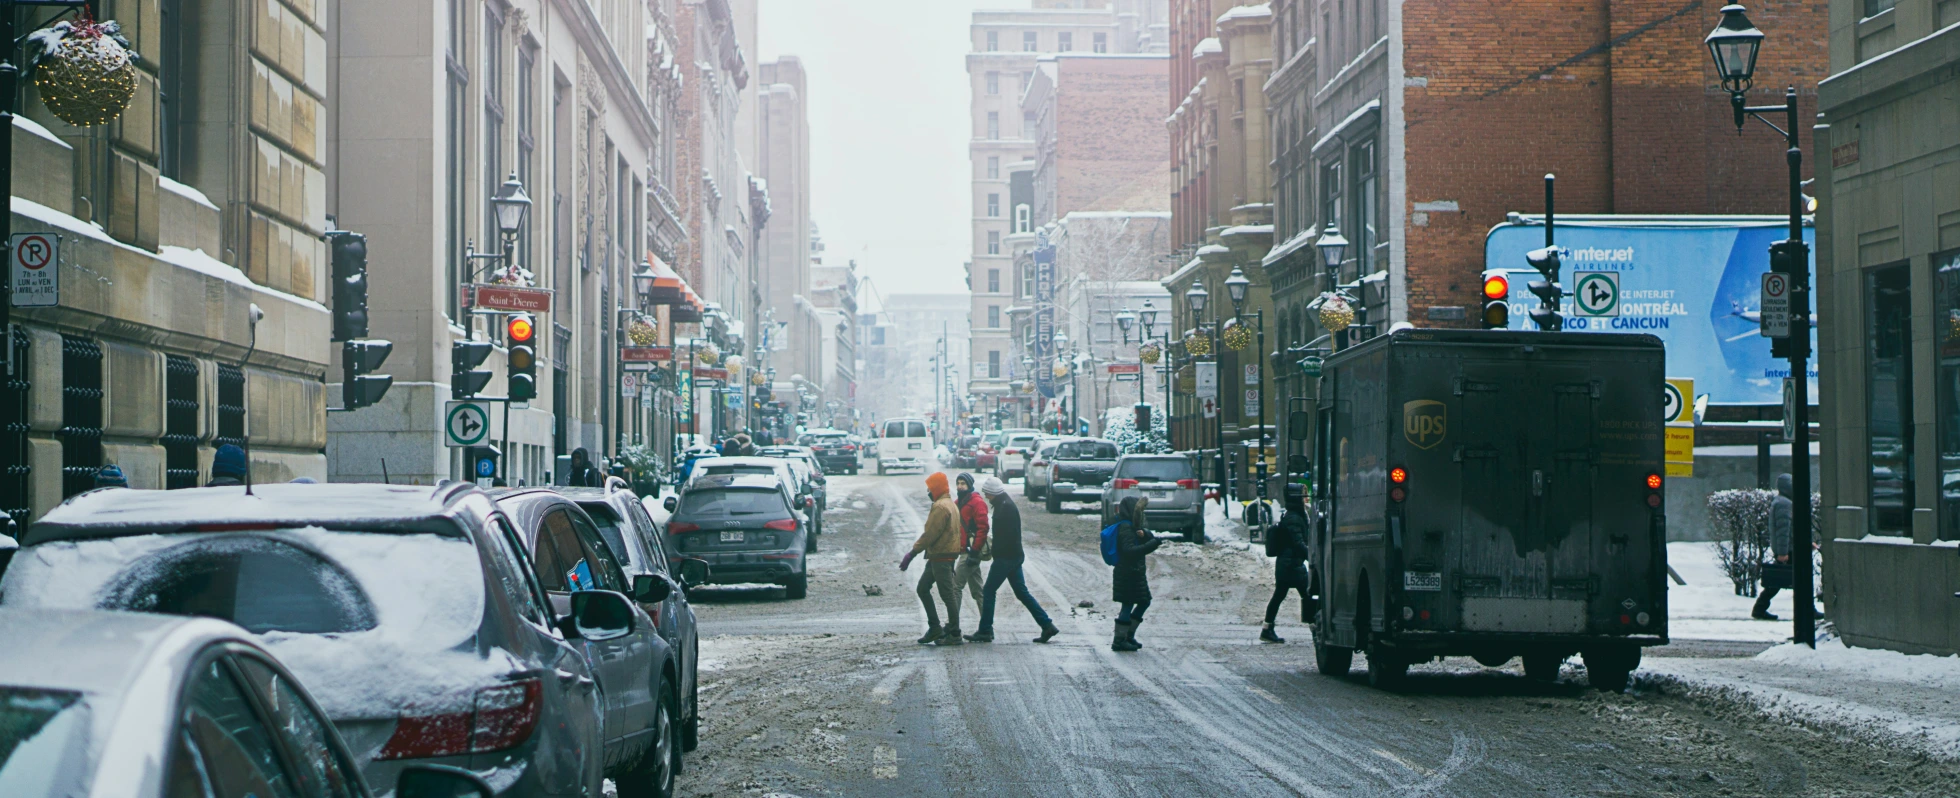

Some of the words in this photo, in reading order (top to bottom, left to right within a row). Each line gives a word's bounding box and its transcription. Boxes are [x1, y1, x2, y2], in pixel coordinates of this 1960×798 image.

[1573, 246, 1634, 261] interjet
[1573, 262, 1635, 270] AIRLINES
[17, 278, 31, 286] LUN
[38, 278, 51, 286] VEN
[18, 286, 33, 294] AVRIL
[1633, 289, 1675, 299] INTERJET
[488, 295, 539, 308] Saint-Pierre
[1590, 317, 1609, 329] ET
[1611, 317, 1669, 329] CANCUN
[1038, 314, 1050, 380] SERVICE
[1406, 414, 1444, 442] ups
[1622, 420, 1640, 429] PICK
[1642, 421, 1657, 430] UPS
